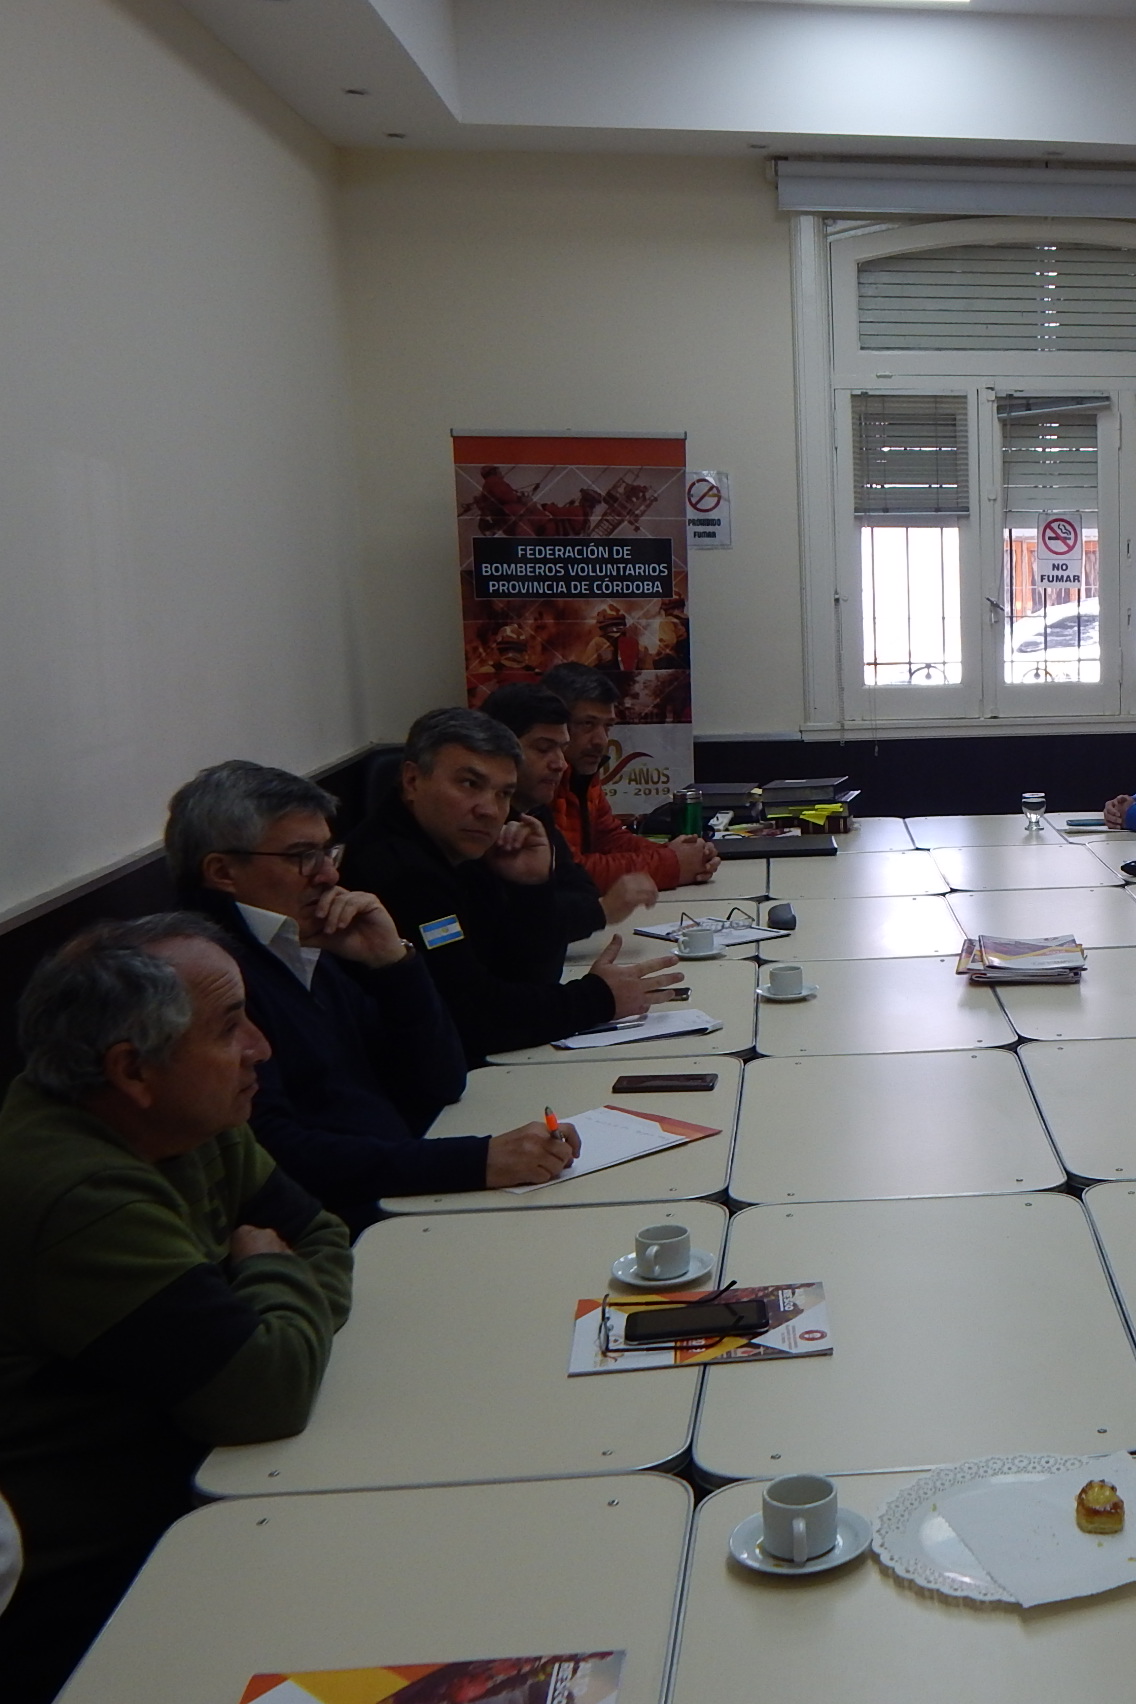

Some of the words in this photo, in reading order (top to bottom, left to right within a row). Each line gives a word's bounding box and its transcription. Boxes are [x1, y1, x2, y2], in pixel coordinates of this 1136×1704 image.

[517, 542, 609, 559] FEDERACIÓN
[613, 546, 632, 559] DE
[481, 563, 565, 576] BOMBEROS
[568, 563, 668, 577] VOLUNTARIOS
[1052, 563, 1069, 572] NO
[489, 581, 567, 594] PROVINCIA
[571, 581, 590, 594] DE
[593, 577, 663, 594] CÓRDOBA
[1040, 574, 1081, 583] FUMAR
[627, 762, 670, 785] AÑOS
[633, 787, 670, 796] 2019
